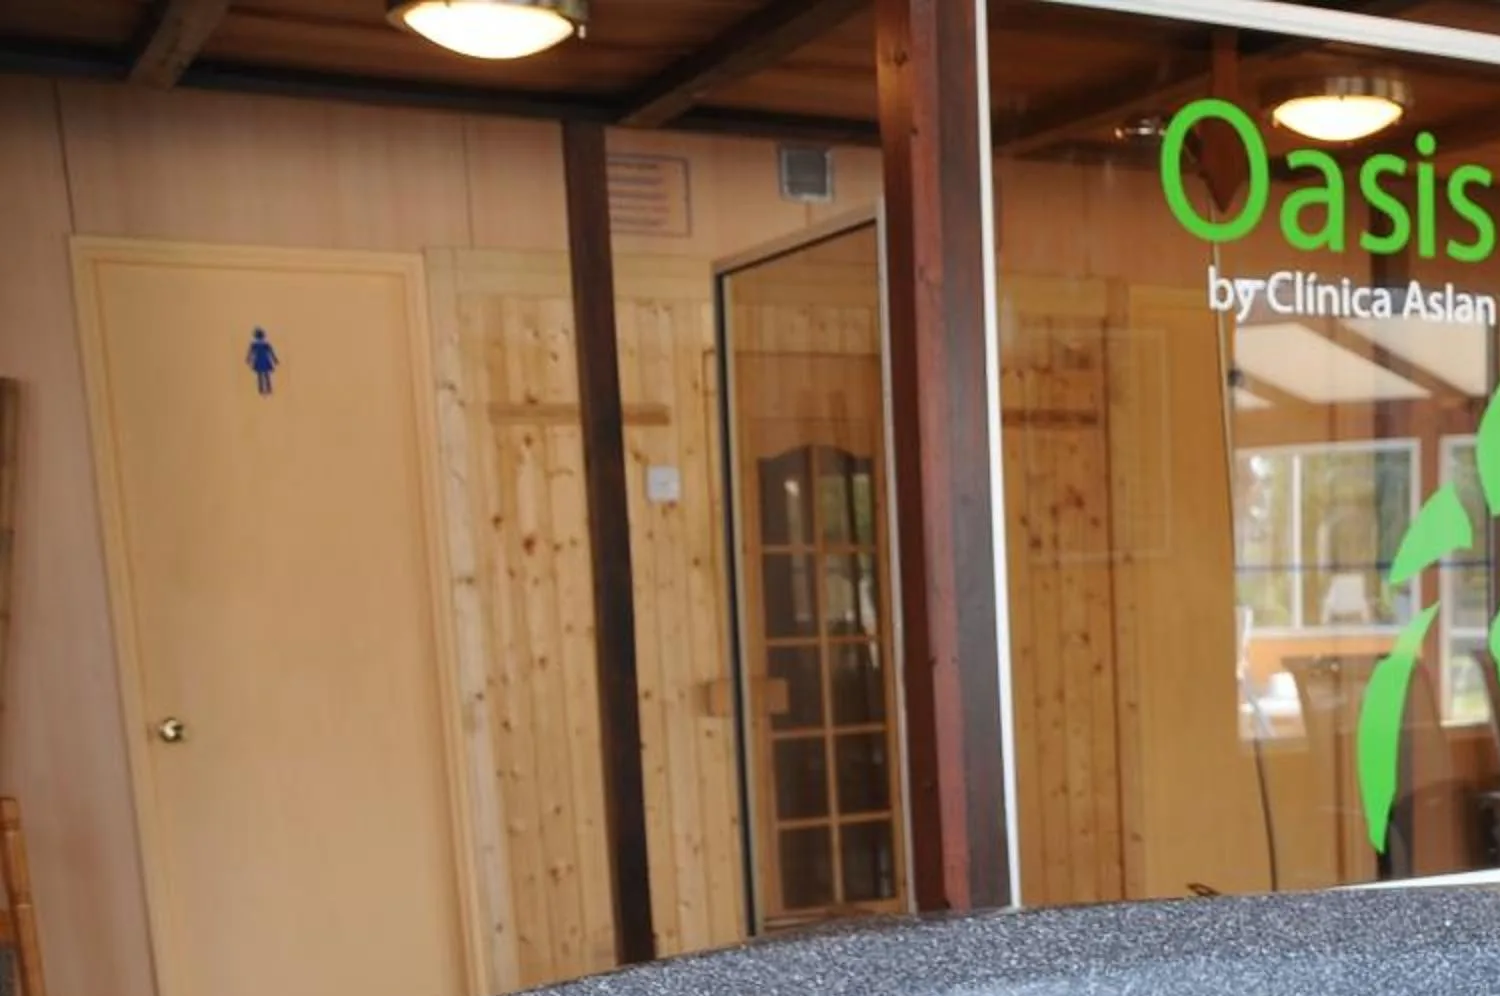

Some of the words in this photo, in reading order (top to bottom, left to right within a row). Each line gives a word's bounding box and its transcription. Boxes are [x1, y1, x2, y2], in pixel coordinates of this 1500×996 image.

[1160, 98, 1497, 262] Oasis
[1207, 265, 1264, 322] by
[1267, 270, 1392, 319] Clínica
[1402, 279, 1497, 327] Aslan
